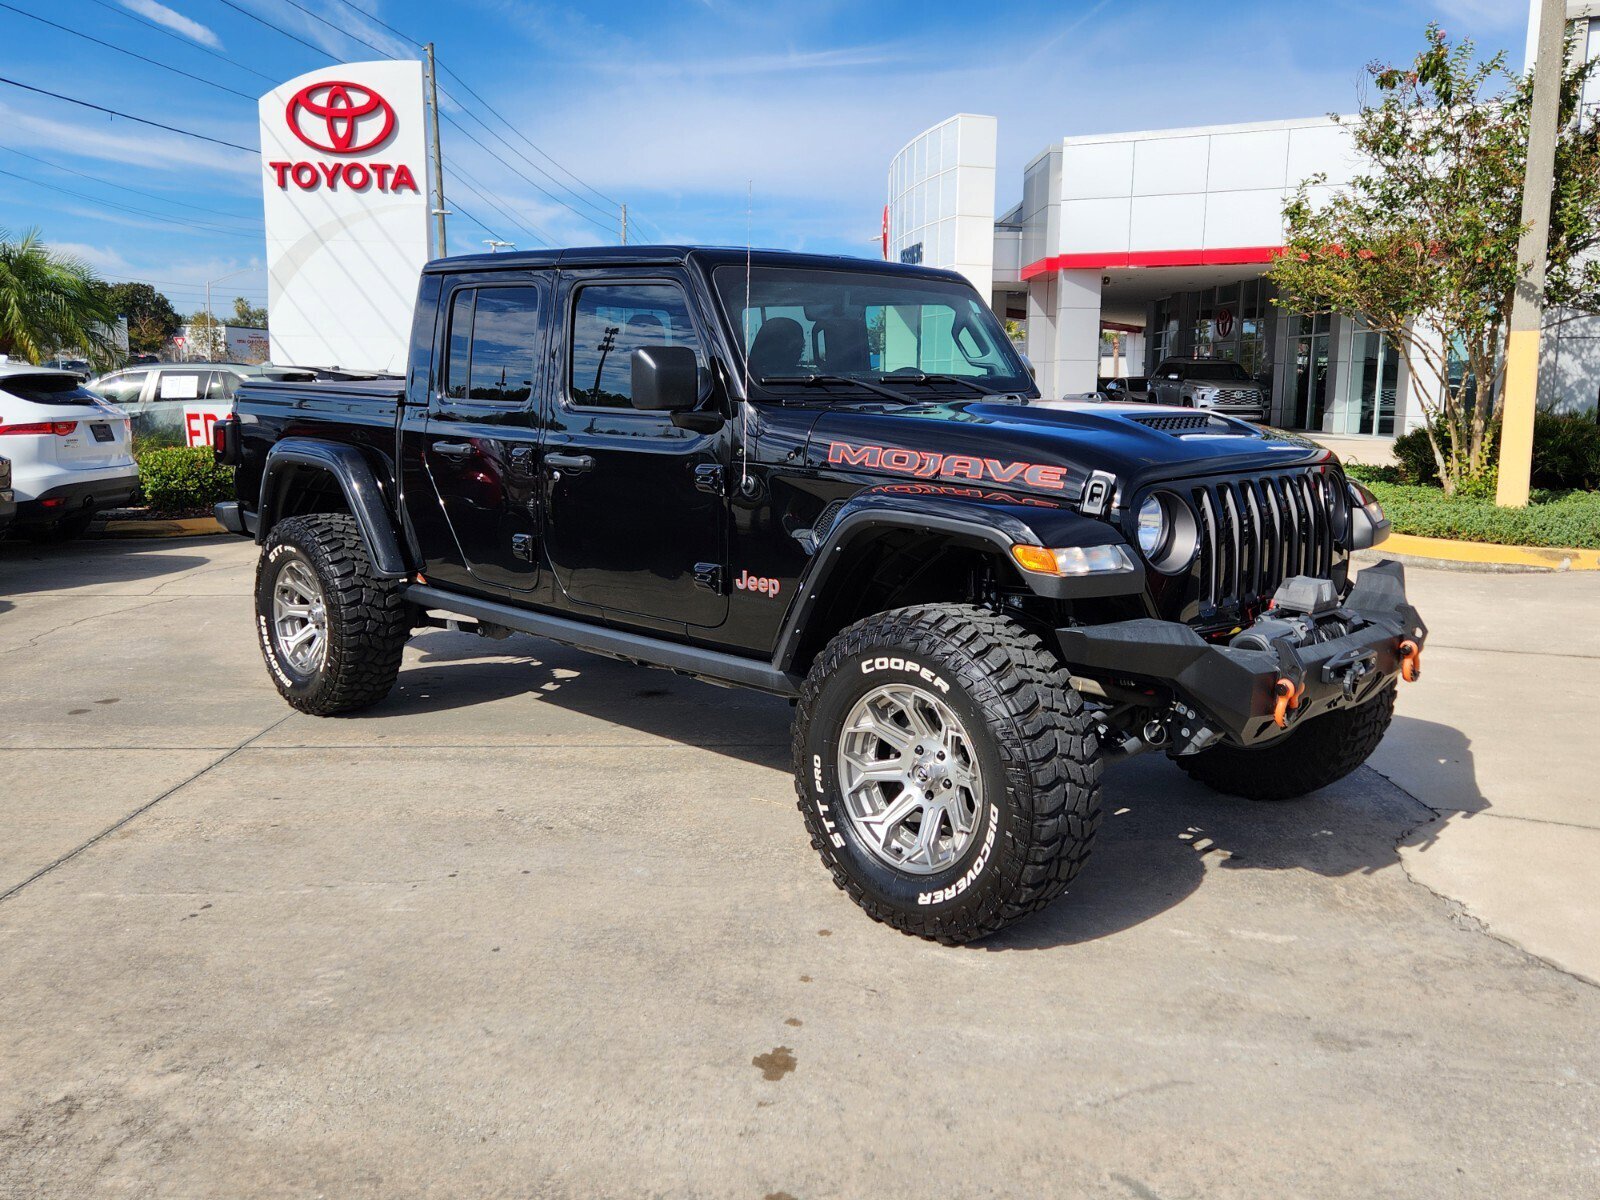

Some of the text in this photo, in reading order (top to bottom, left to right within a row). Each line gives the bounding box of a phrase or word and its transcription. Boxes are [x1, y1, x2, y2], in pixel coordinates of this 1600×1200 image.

[269, 161, 417, 192] TOYOTA
[828, 441, 1067, 489] MOJAVE
[269, 544, 283, 563] STT
[735, 570, 780, 598] Jeep
[861, 657, 950, 694] COOPER
[813, 754, 846, 849] STT PRO
[917, 802, 999, 905] DISCOVERER
